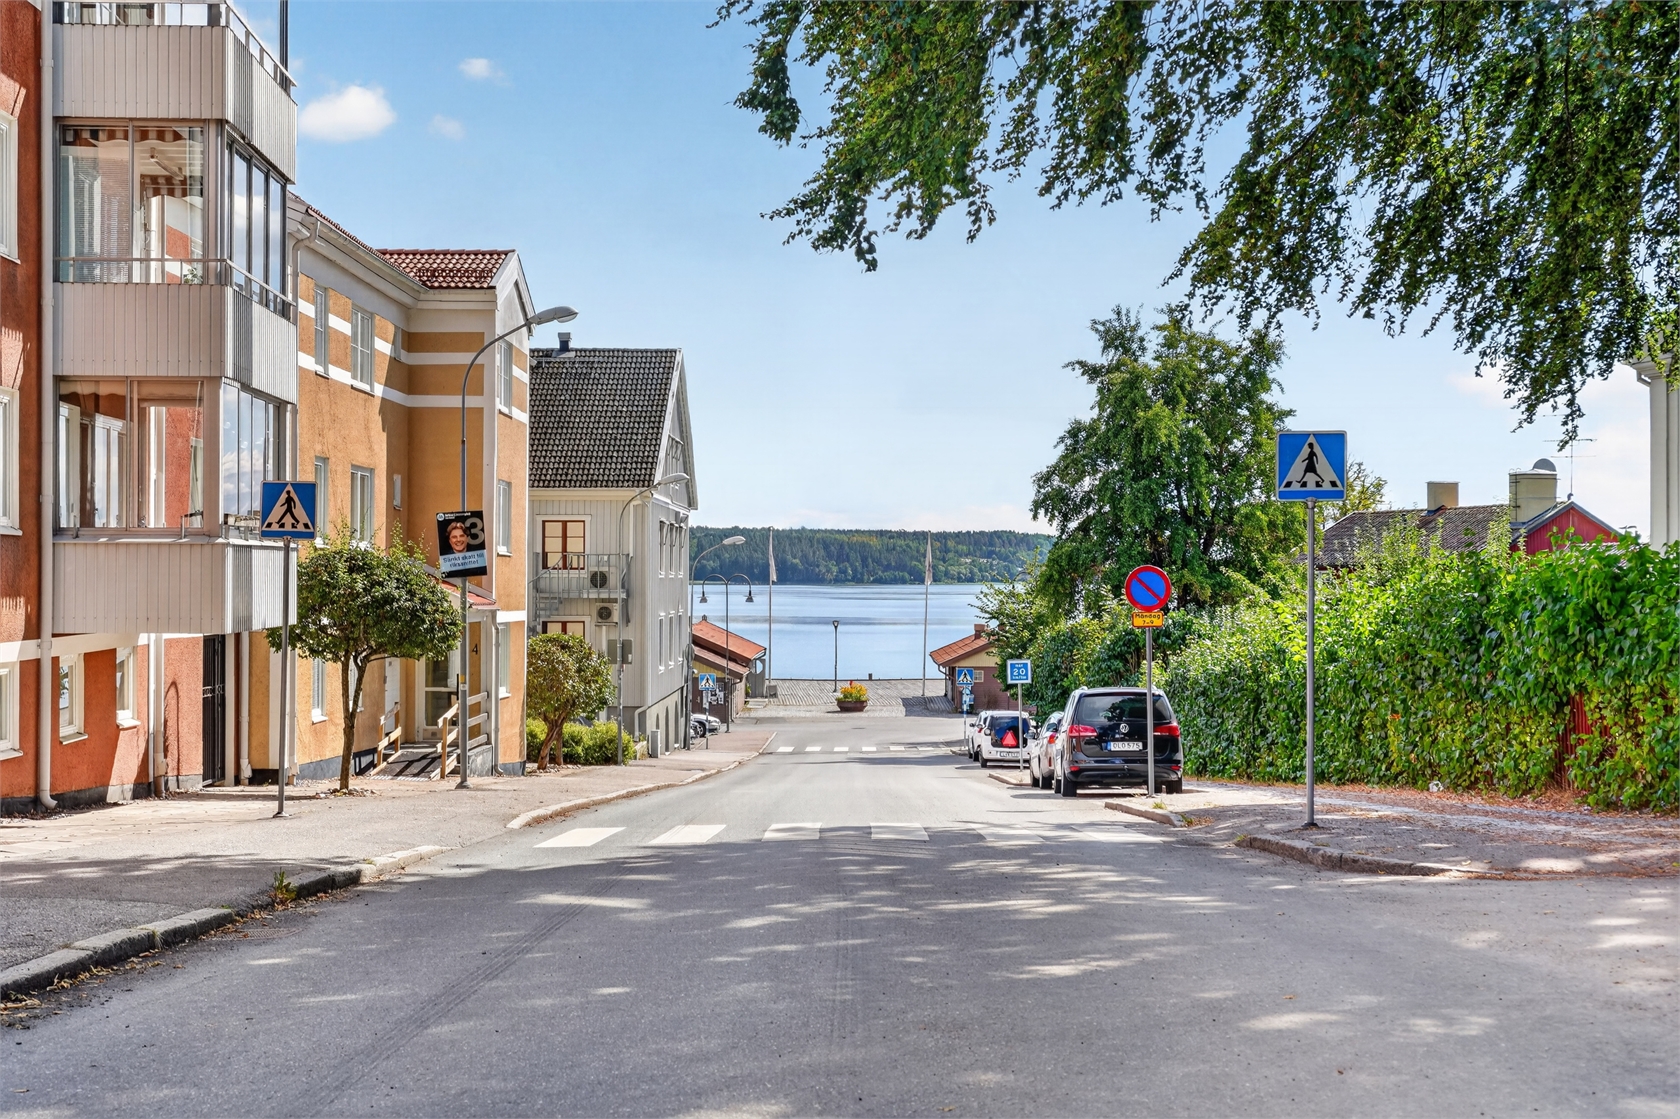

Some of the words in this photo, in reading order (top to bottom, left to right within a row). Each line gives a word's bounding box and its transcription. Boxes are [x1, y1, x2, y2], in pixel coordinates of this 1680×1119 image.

[464, 517, 485, 545] 3
[471, 643, 479, 655] 4
[1013, 668, 1026, 676] 20
